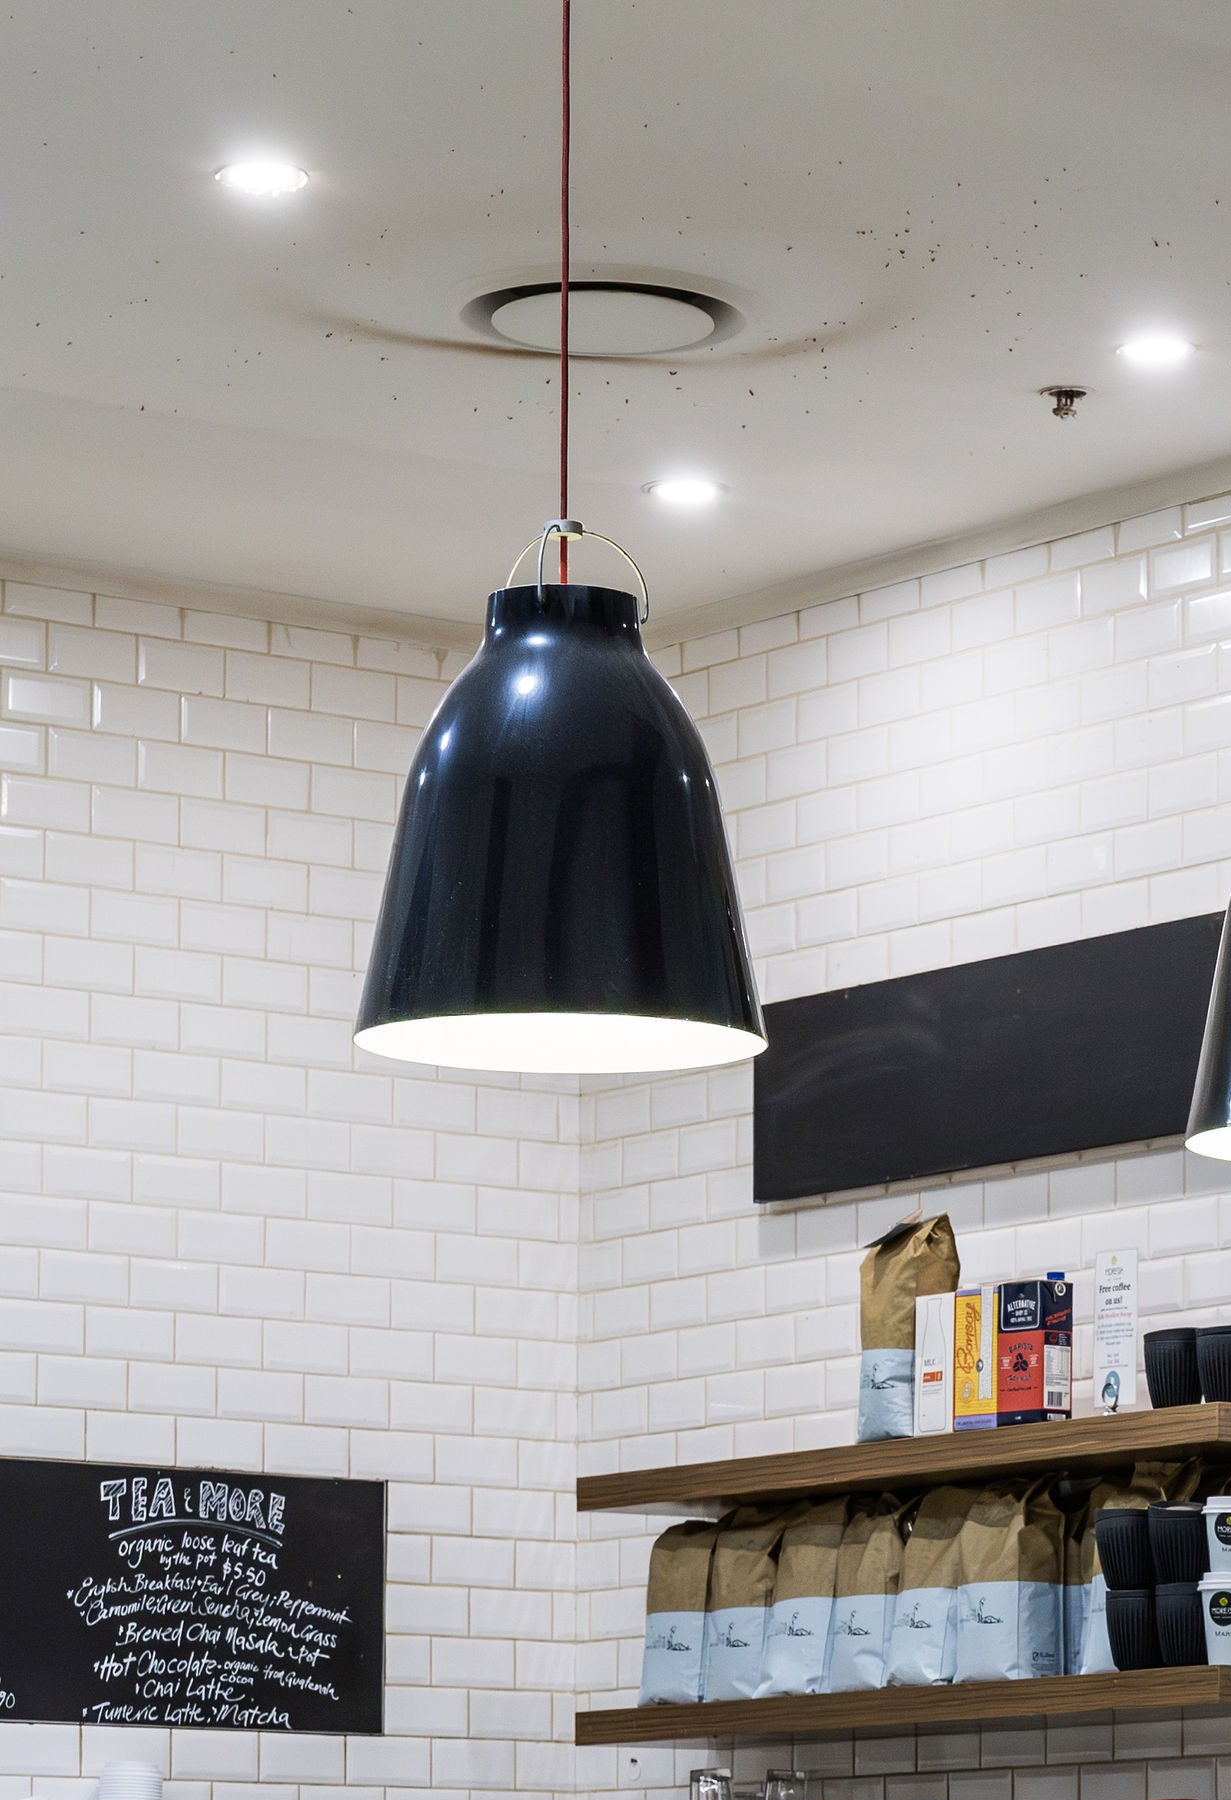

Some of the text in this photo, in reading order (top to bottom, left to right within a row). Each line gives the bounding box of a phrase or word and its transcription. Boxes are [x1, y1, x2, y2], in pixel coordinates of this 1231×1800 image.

[1112, 1282, 1131, 1292] coffee
[1007, 1299, 1036, 1312] ALTERNATIVE
[957, 1302, 981, 1375] Bonsoy
[100, 1477, 176, 1521] TEA
[199, 1480, 286, 1535] MORE
[118, 1531, 279, 1570] organic loose leaf tea
[195, 1553, 217, 1570] pot
[222, 1560, 267, 1587] $5.50
[201, 1574, 232, 1598] Earl
[276, 1587, 352, 1623] Peppermint
[186, 1622, 222, 1645] Chai
[225, 1626, 285, 1656] Masala
[299, 1626, 338, 1648] Grass
[98, 1652, 137, 1682] Hot
[137, 1650, 217, 1678] Chocolate
[220, 1673, 255, 1686] cocoa
[142, 1679, 246, 1701] Chai Latte
[93, 1702, 293, 1730] Tumeric Matcha
